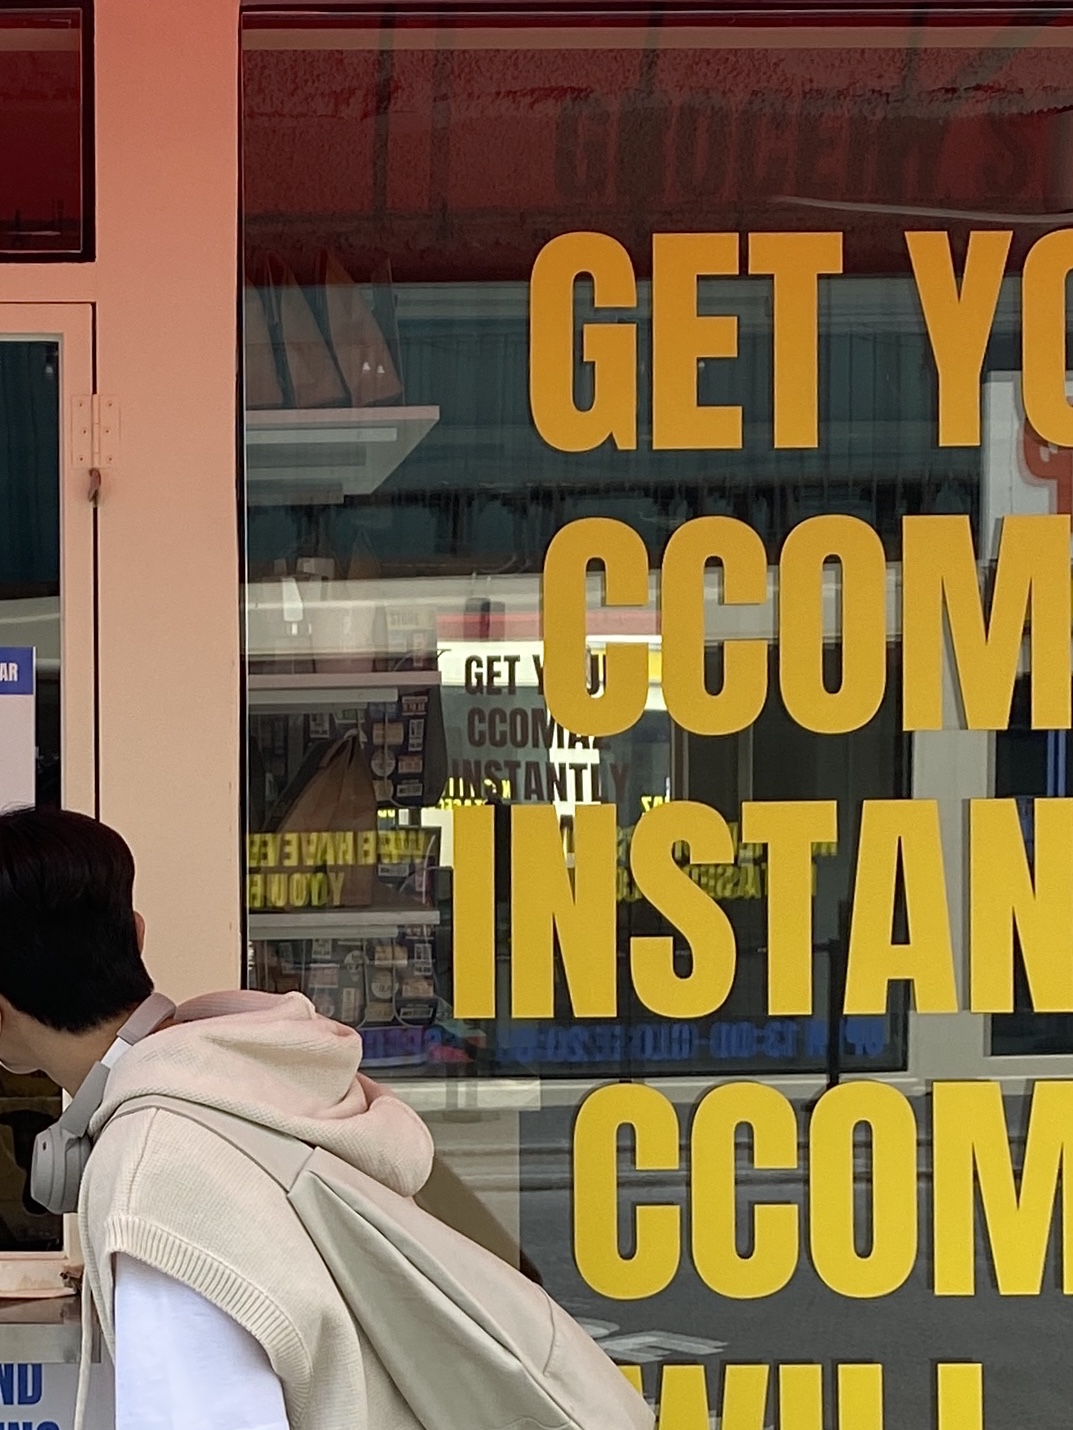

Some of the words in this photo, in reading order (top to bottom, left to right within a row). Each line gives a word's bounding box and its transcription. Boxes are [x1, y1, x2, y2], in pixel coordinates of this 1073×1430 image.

[529, 231, 844, 452] GET
[465, 655, 520, 696] GET
[467, 707, 612, 749] CCOM
[543, 514, 1072, 736] CCOM
[453, 798, 1073, 1018] INSTAN
[573, 1080, 1073, 1300] CCOM
